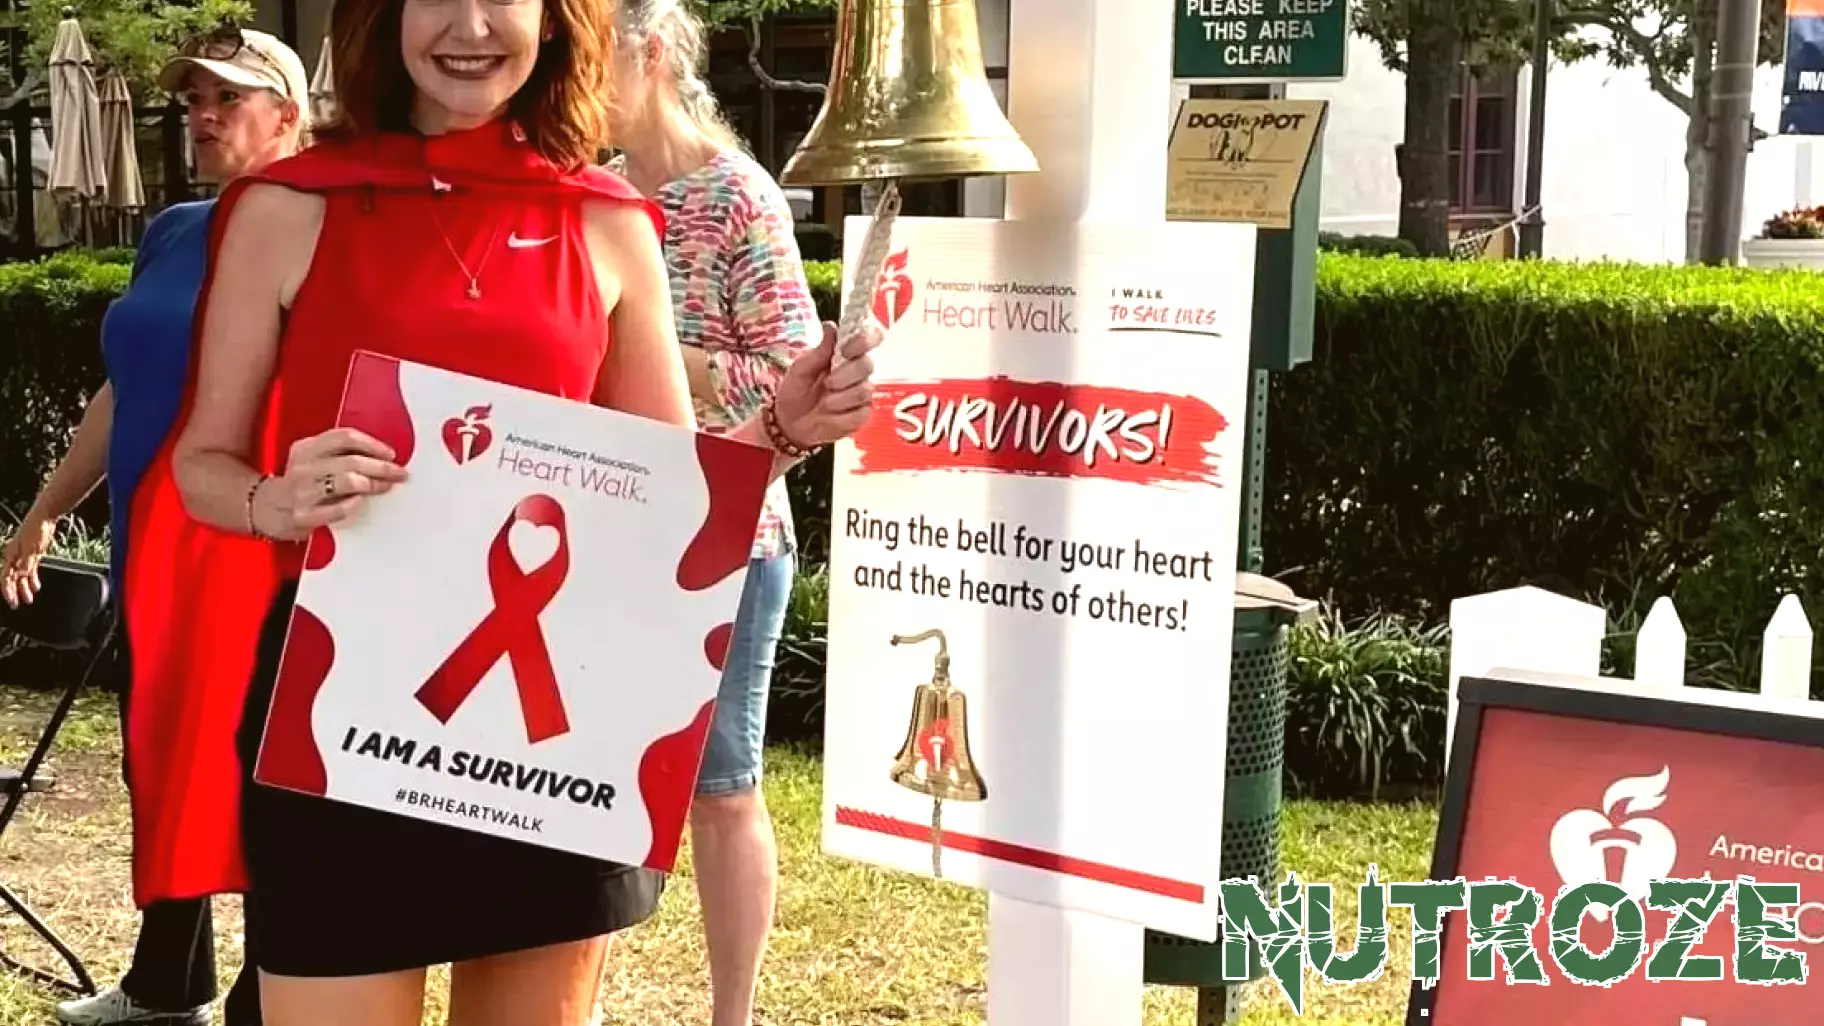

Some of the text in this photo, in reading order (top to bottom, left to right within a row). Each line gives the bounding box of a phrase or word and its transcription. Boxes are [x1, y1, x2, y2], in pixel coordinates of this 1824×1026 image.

[1186, 0, 1334, 16] PLEASE KEEP
[1202, 20, 1315, 41] THIS AREA
[1223, 45, 1292, 64] CLEAN
[926, 279, 976, 293] American
[978, 281, 1008, 293] Heart
[1111, 287, 1164, 299] I WALK
[923, 297, 997, 330] Heart
[1108, 304, 1217, 325] TO SAVE LIVES
[894, 393, 1173, 466] SURVIVORS!
[505, 432, 555, 452] American
[557, 444, 587, 459] Heart
[497, 446, 573, 486] Heart
[846, 508, 1214, 582] Ring the bell for your heart
[854, 561, 1188, 632] and the hearts of others!
[341, 726, 617, 810] I AM A SURVIVOR
[395, 787, 544, 833] #BRHEARTWALK
